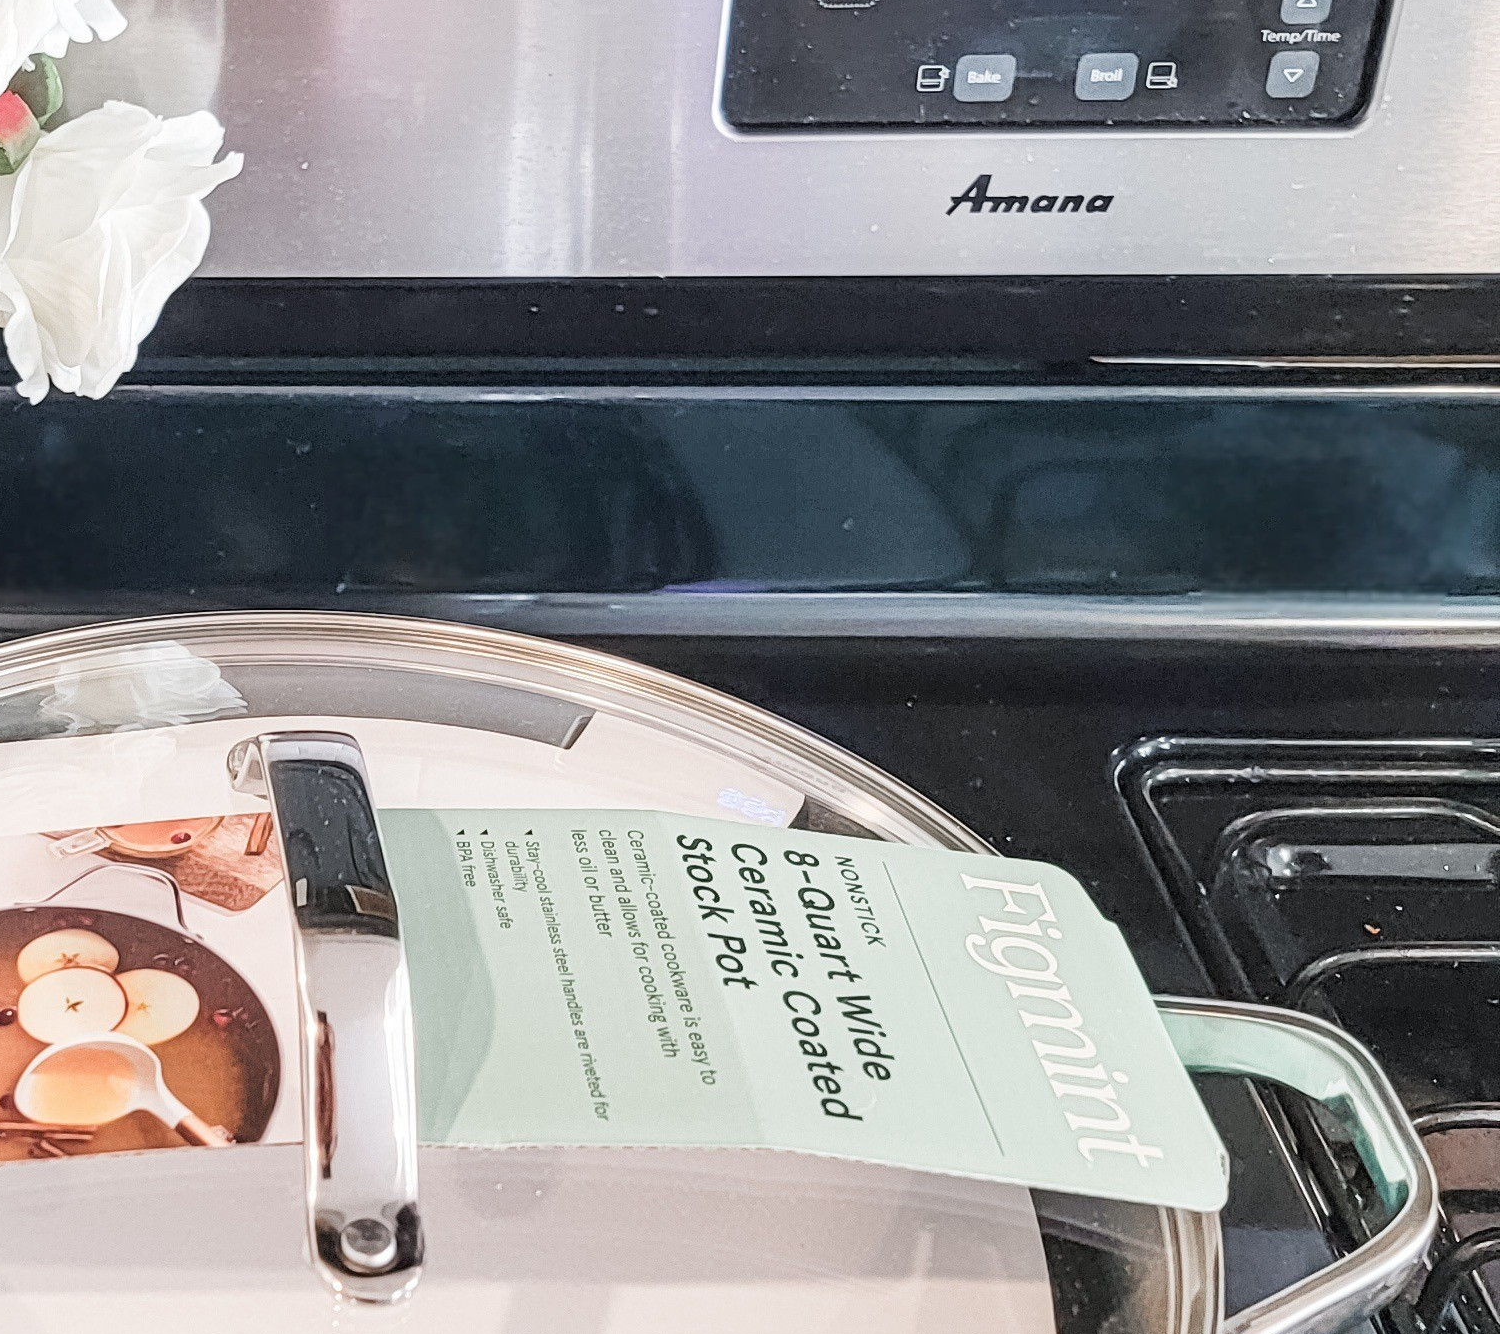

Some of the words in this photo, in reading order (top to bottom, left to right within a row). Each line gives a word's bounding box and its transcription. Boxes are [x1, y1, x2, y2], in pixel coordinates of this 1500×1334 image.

[1260, 29, 1342, 45] Temp/Time
[967, 69, 1002, 84] Bake
[1090, 68, 1123, 82] Broil
[945, 174, 1115, 217] Amana
[455, 840, 474, 863] BPA
[570, 829, 589, 854] less
[598, 829, 620, 865] clean
[461, 864, 477, 888] free
[504, 840, 528, 893] durability
[525, 840, 553, 894] Stay-cool
[578, 856, 599, 873] oil
[610, 867, 633, 893] and
[480, 840, 506, 904] Dishwasher
[495, 905, 514, 930] safe
[583, 876, 600, 892] or
[627, 829, 677, 940] Ceramic-coated
[834, 855, 887, 948] NONSTICK
[539, 896, 563, 945] stainless
[588, 895, 613, 938] butter
[617, 896, 639, 938] allows
[676, 834, 735, 924] Stock
[706, 932, 760, 990] Pot
[552, 947, 574, 976] steel
[630, 941, 649, 963] for
[783, 850, 863, 983] 8-Quart
[836, 995, 895, 1081] Wide
[638, 966, 668, 1024] cooking
[661, 943, 693, 1013] cookware
[730, 843, 804, 978] Ceramic
[782, 990, 864, 1122] Coated
[561, 978, 584, 1027] handles
[959, 872, 1165, 1169] Figmint
[573, 1028, 589, 1051] are
[682, 1017, 702, 1028] is
[656, 1026, 681, 1058] with
[688, 1031, 711, 1066] easy
[579, 1052, 607, 1099] riveted
[700, 1069, 718, 1086] to
[593, 1101, 610, 1122] for
